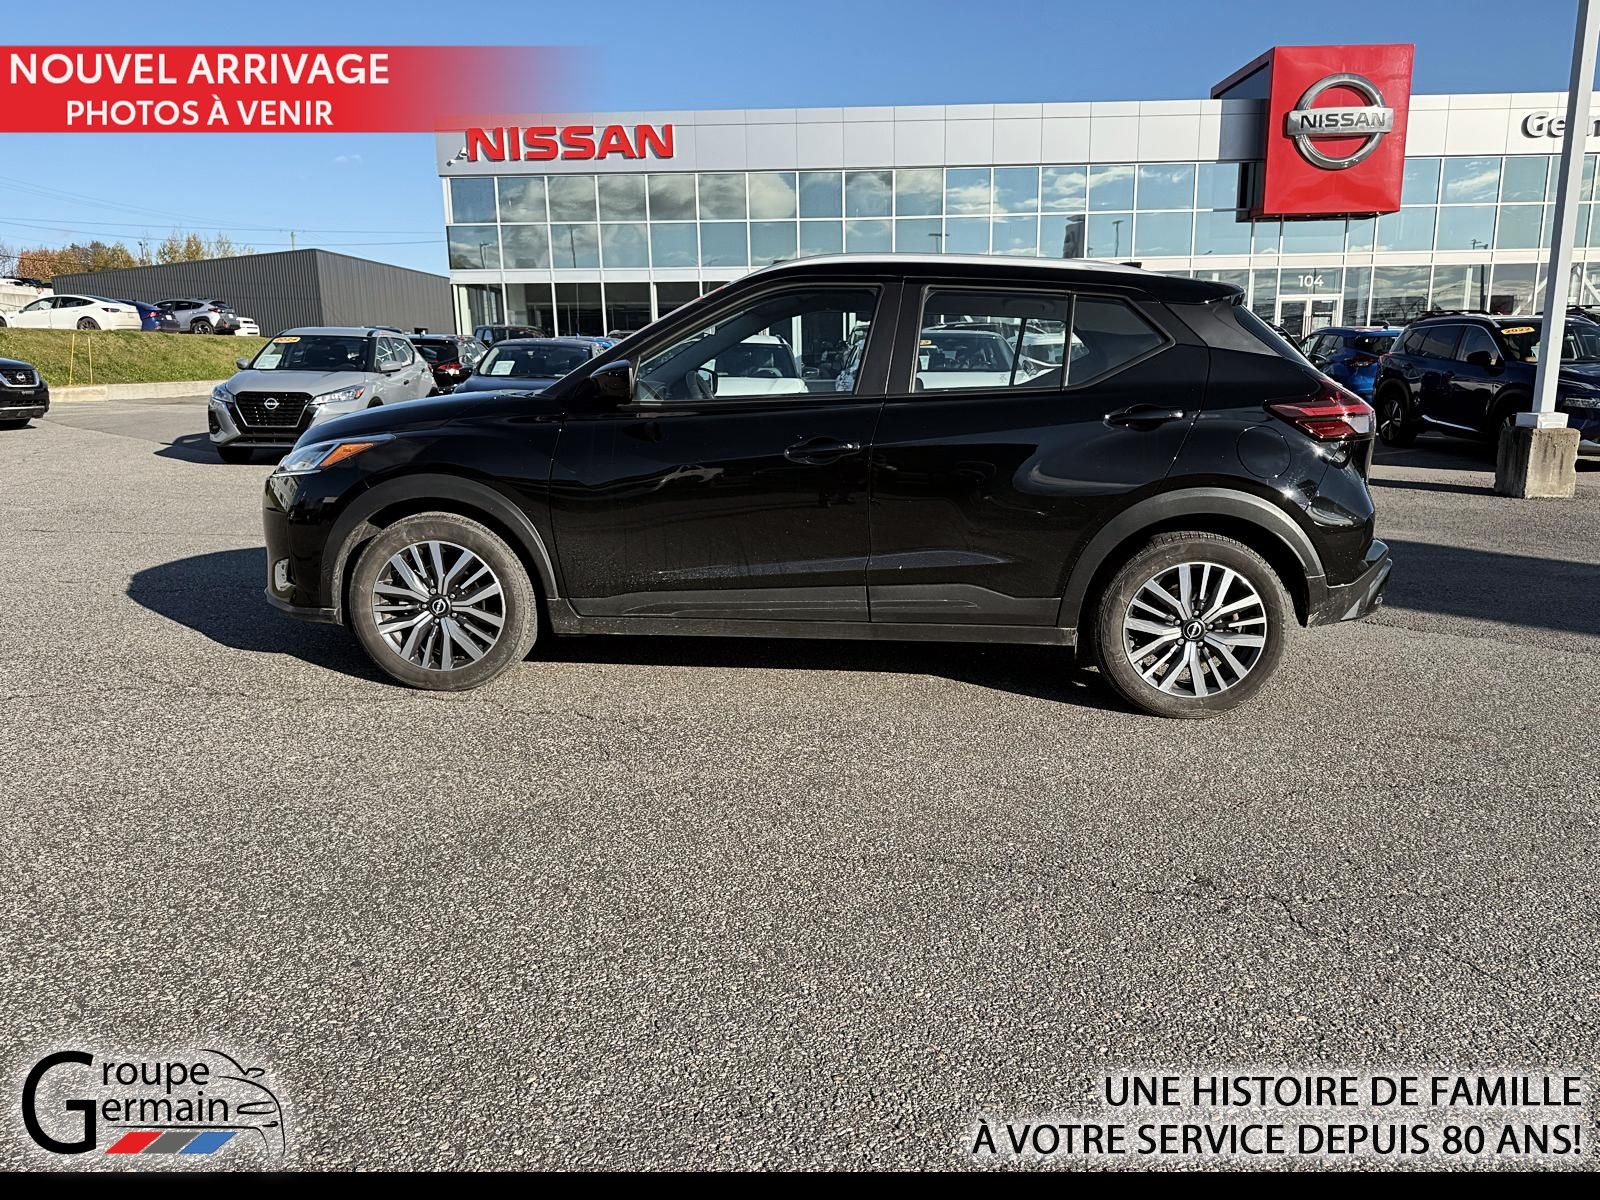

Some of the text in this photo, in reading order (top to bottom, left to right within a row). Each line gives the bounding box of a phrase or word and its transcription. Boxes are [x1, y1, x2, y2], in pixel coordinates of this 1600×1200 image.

[1300, 112, 1386, 129] NISSAN
[466, 124, 674, 162] NISSAN
[1298, 275, 1324, 287] 104
